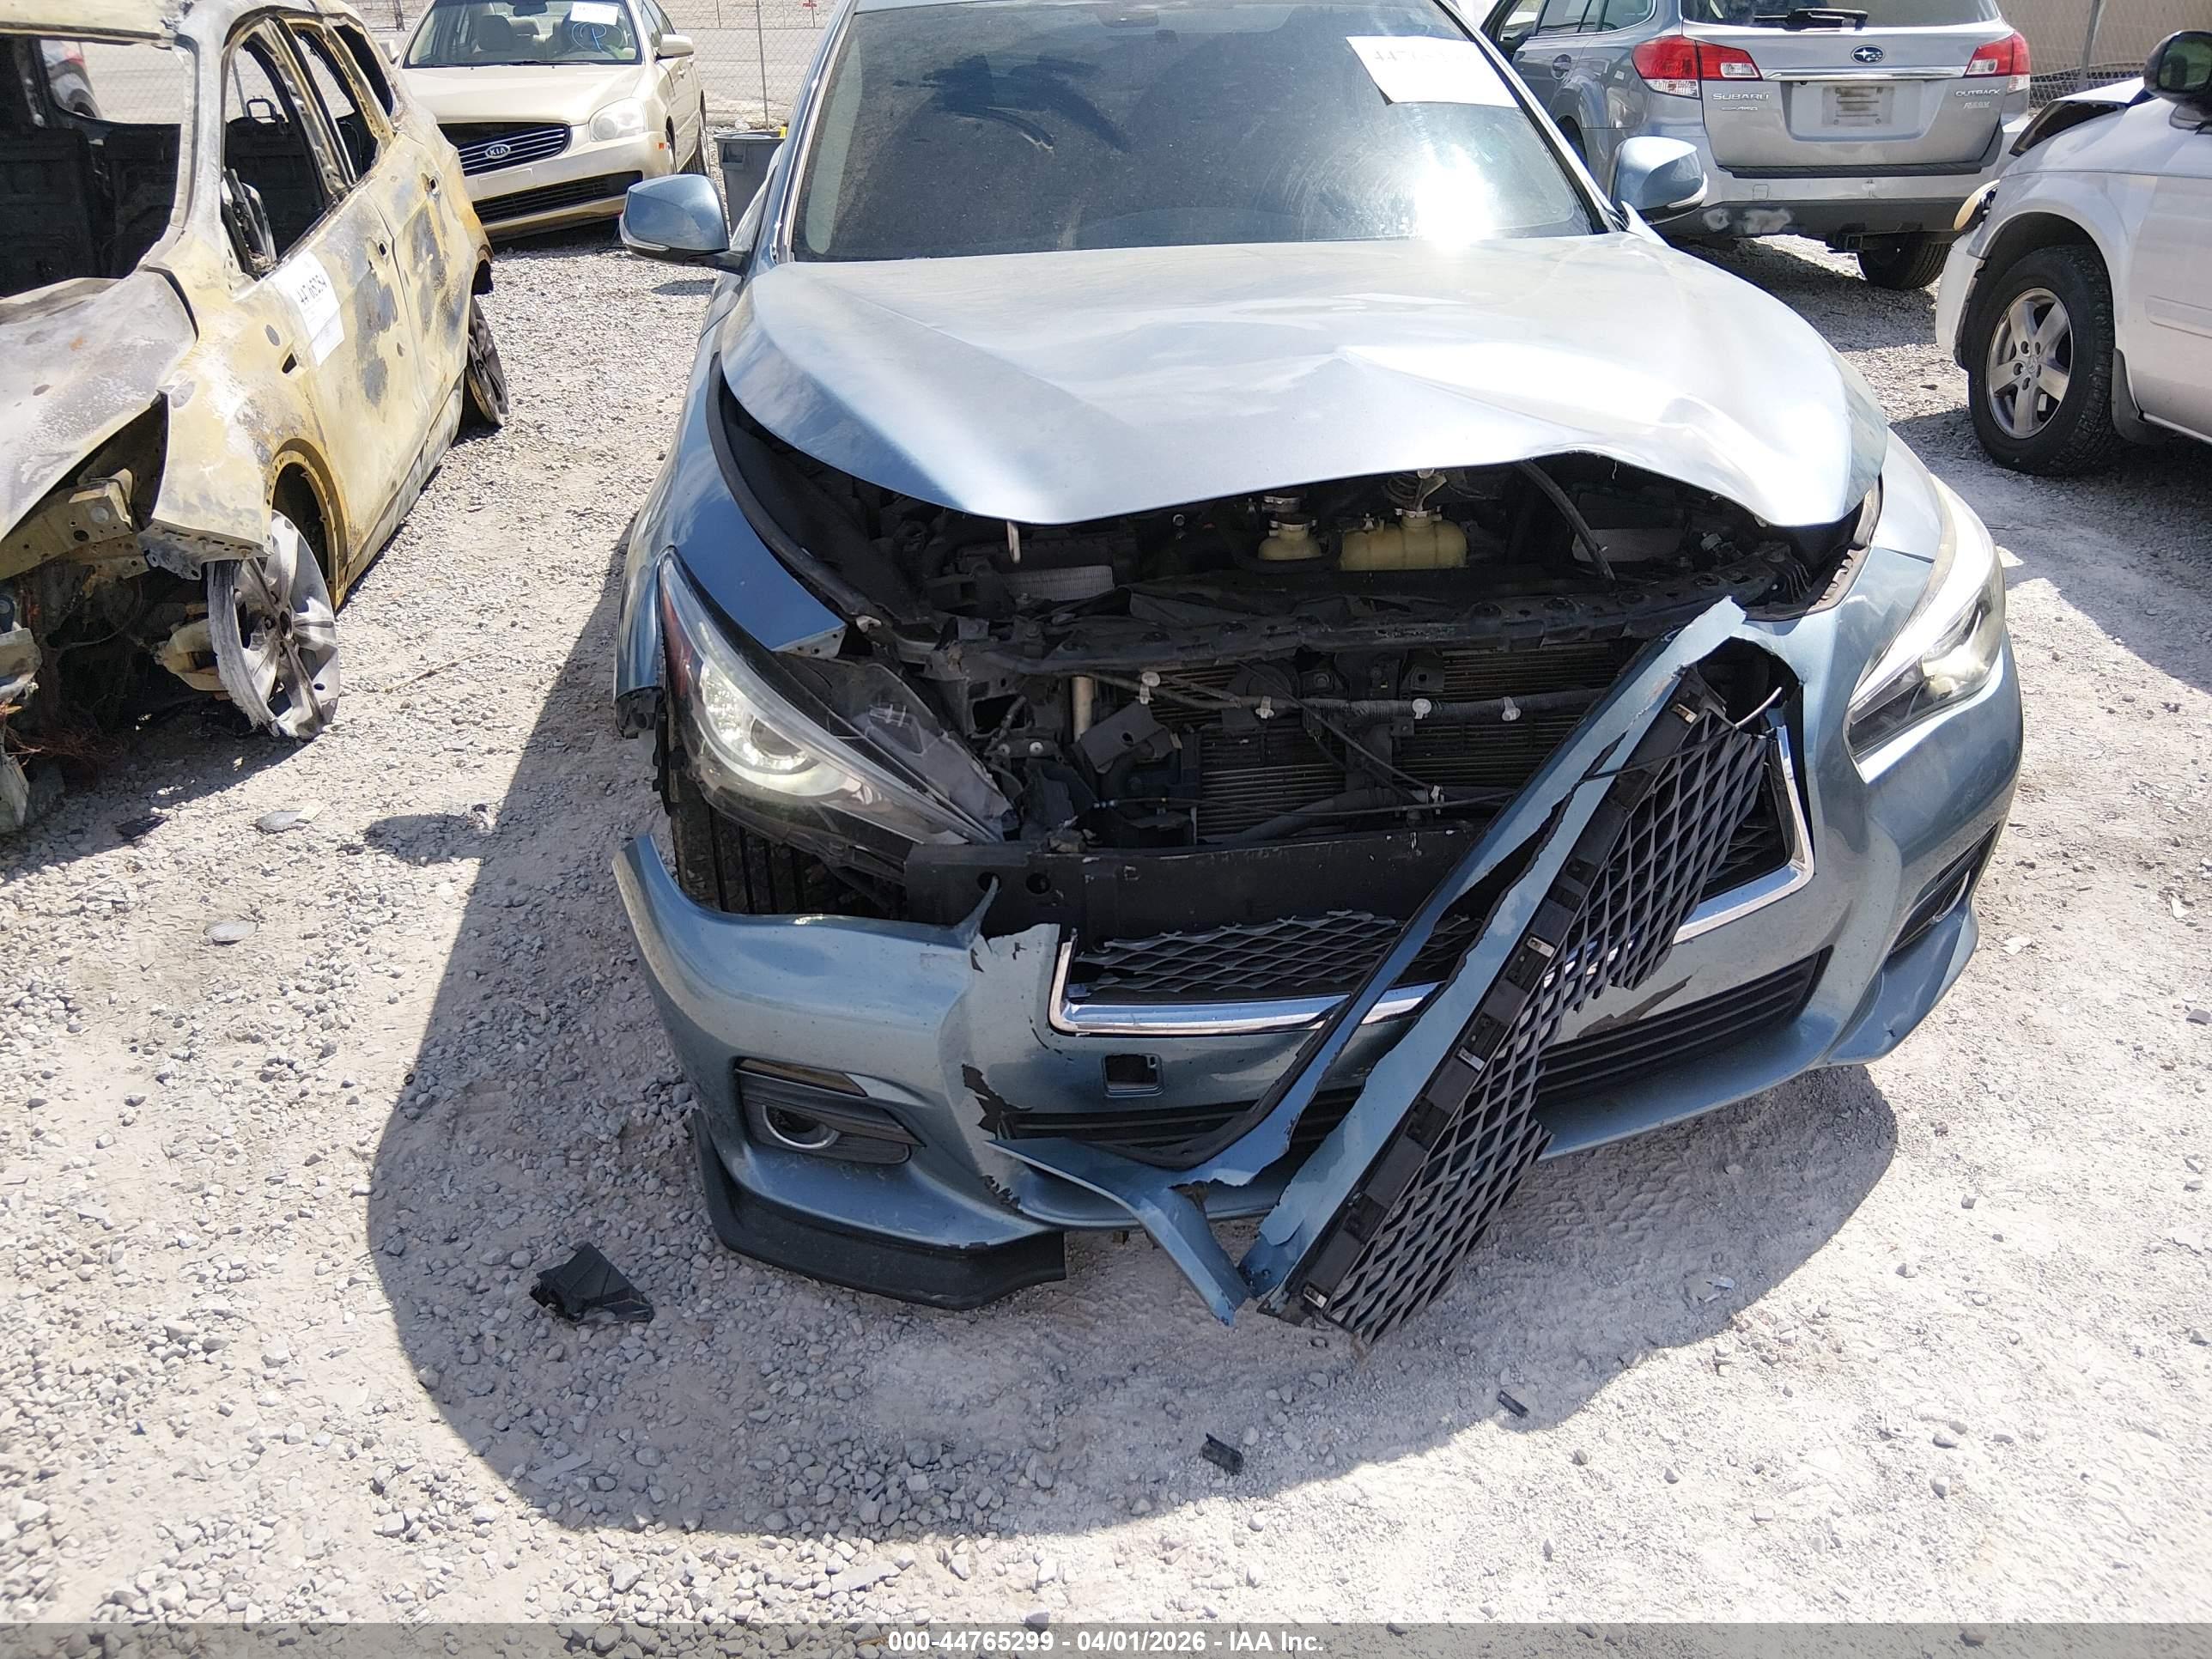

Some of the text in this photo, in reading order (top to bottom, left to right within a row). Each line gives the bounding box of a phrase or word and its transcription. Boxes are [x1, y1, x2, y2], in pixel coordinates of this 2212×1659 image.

[1712, 92, 1770, 101] SUBARU
[1955, 88, 2001, 97] OUTBACK
[489, 146, 507, 156] KIA
